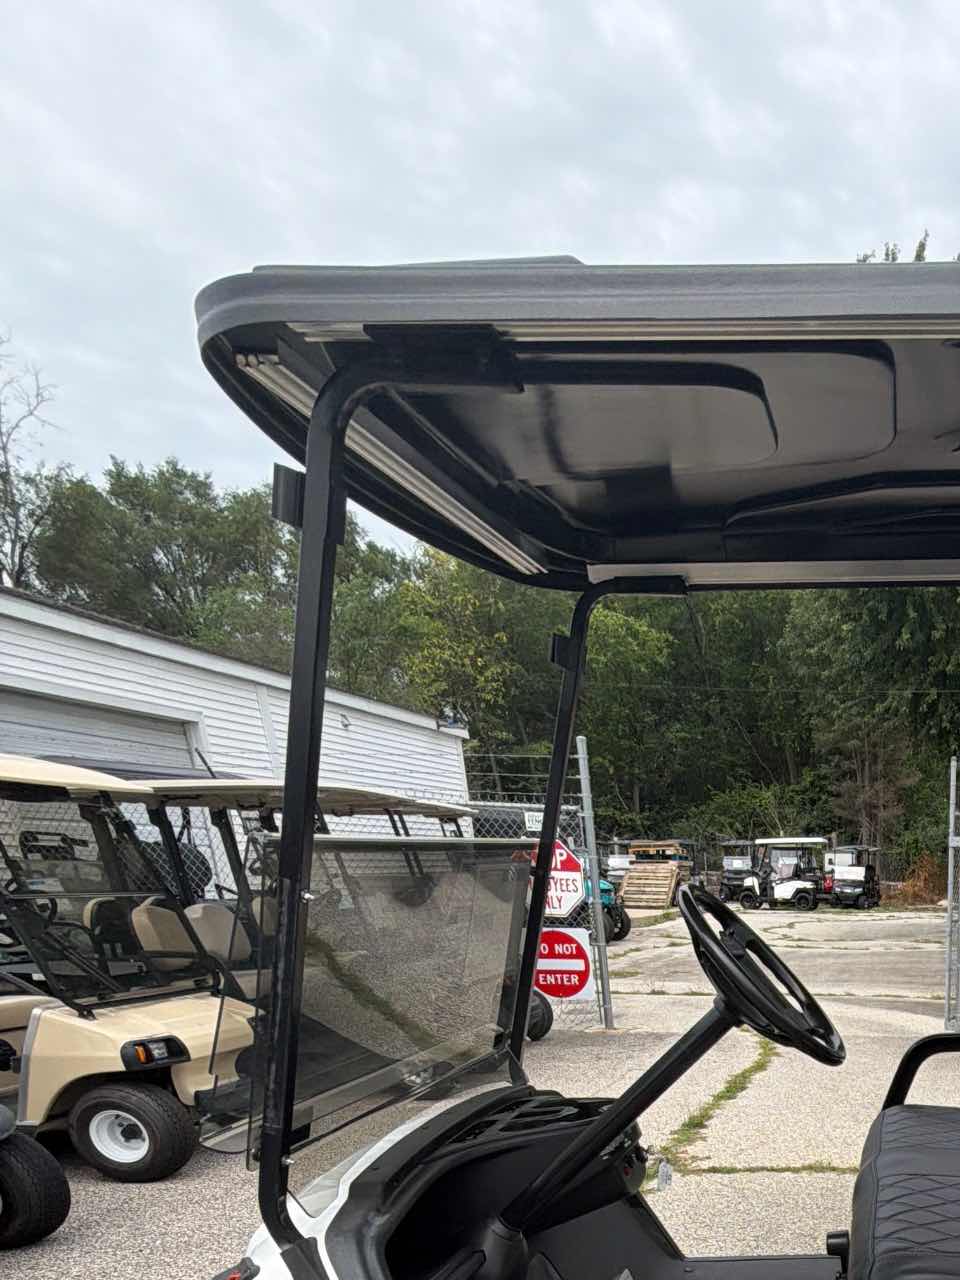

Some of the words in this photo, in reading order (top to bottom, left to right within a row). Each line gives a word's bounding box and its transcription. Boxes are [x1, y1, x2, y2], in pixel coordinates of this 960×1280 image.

[545, 895, 563, 909] NLY
[540, 943, 549, 954] O
[554, 943, 577, 954] NOT
[538, 974, 579, 985] ENTER
